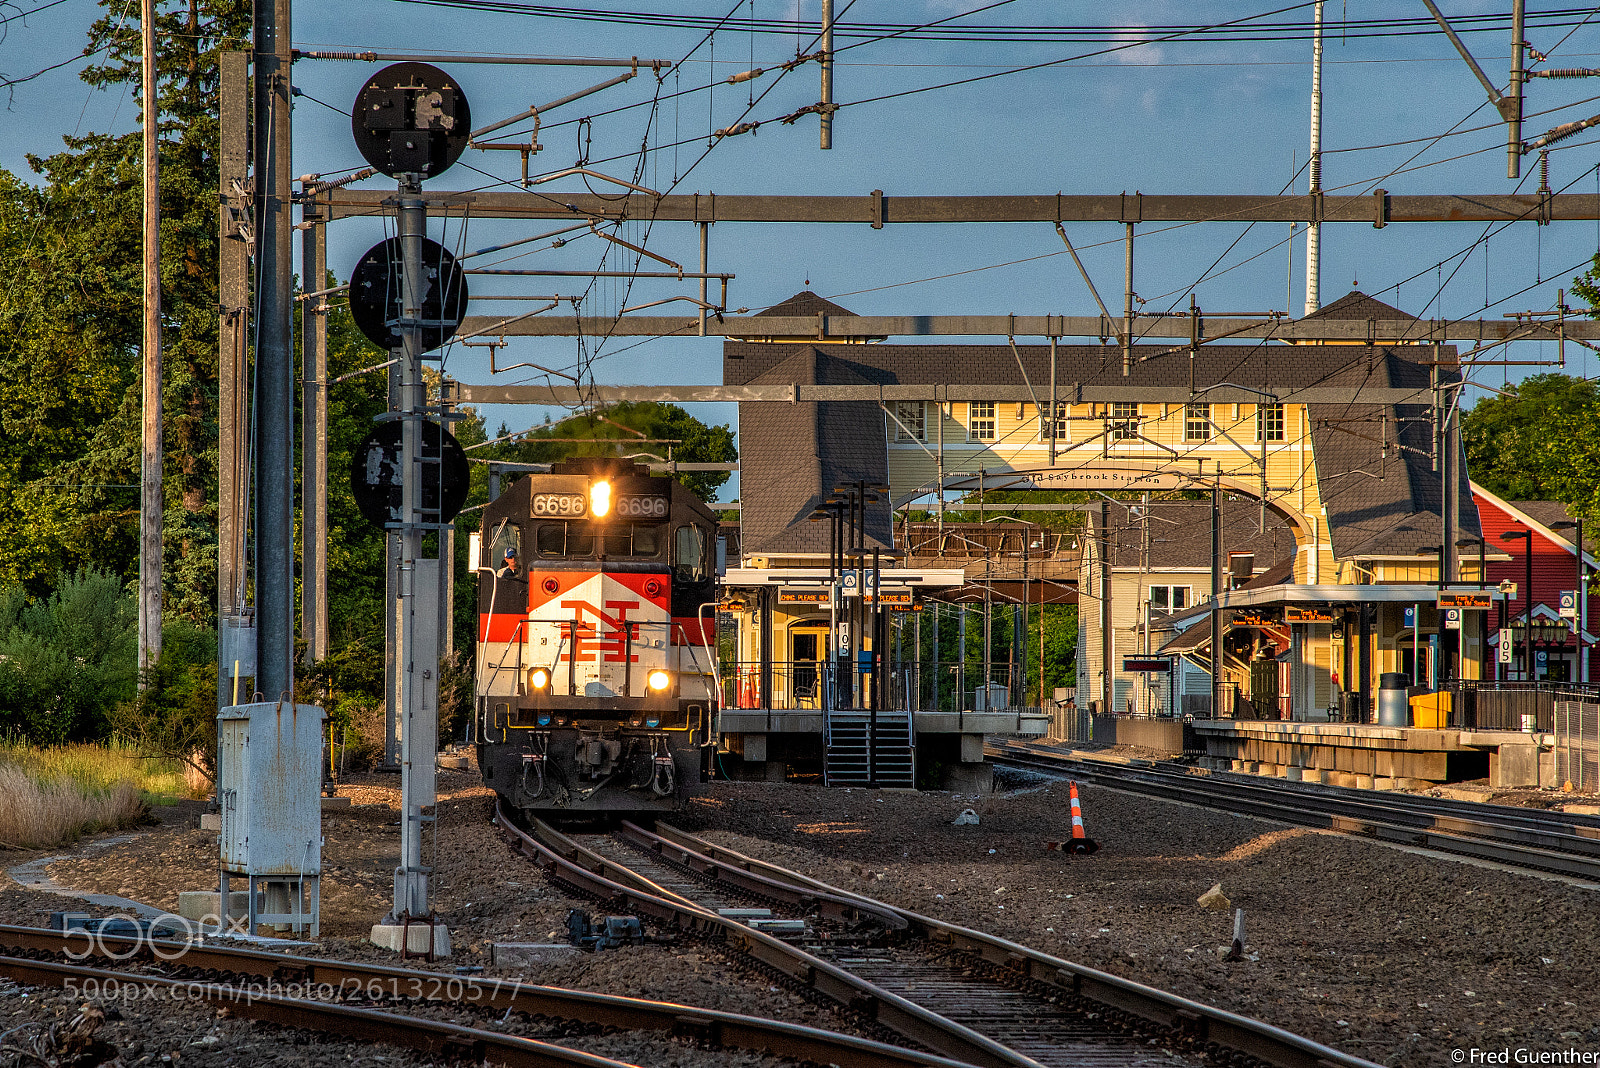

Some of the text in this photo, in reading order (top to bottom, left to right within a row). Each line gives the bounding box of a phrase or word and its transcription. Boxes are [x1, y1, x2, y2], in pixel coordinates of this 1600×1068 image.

[1048, 473, 1108, 482] Saybrook
[533, 496, 583, 515] 6696
[617, 497, 665, 515] 6696
[1502, 630, 1510, 661] 105
